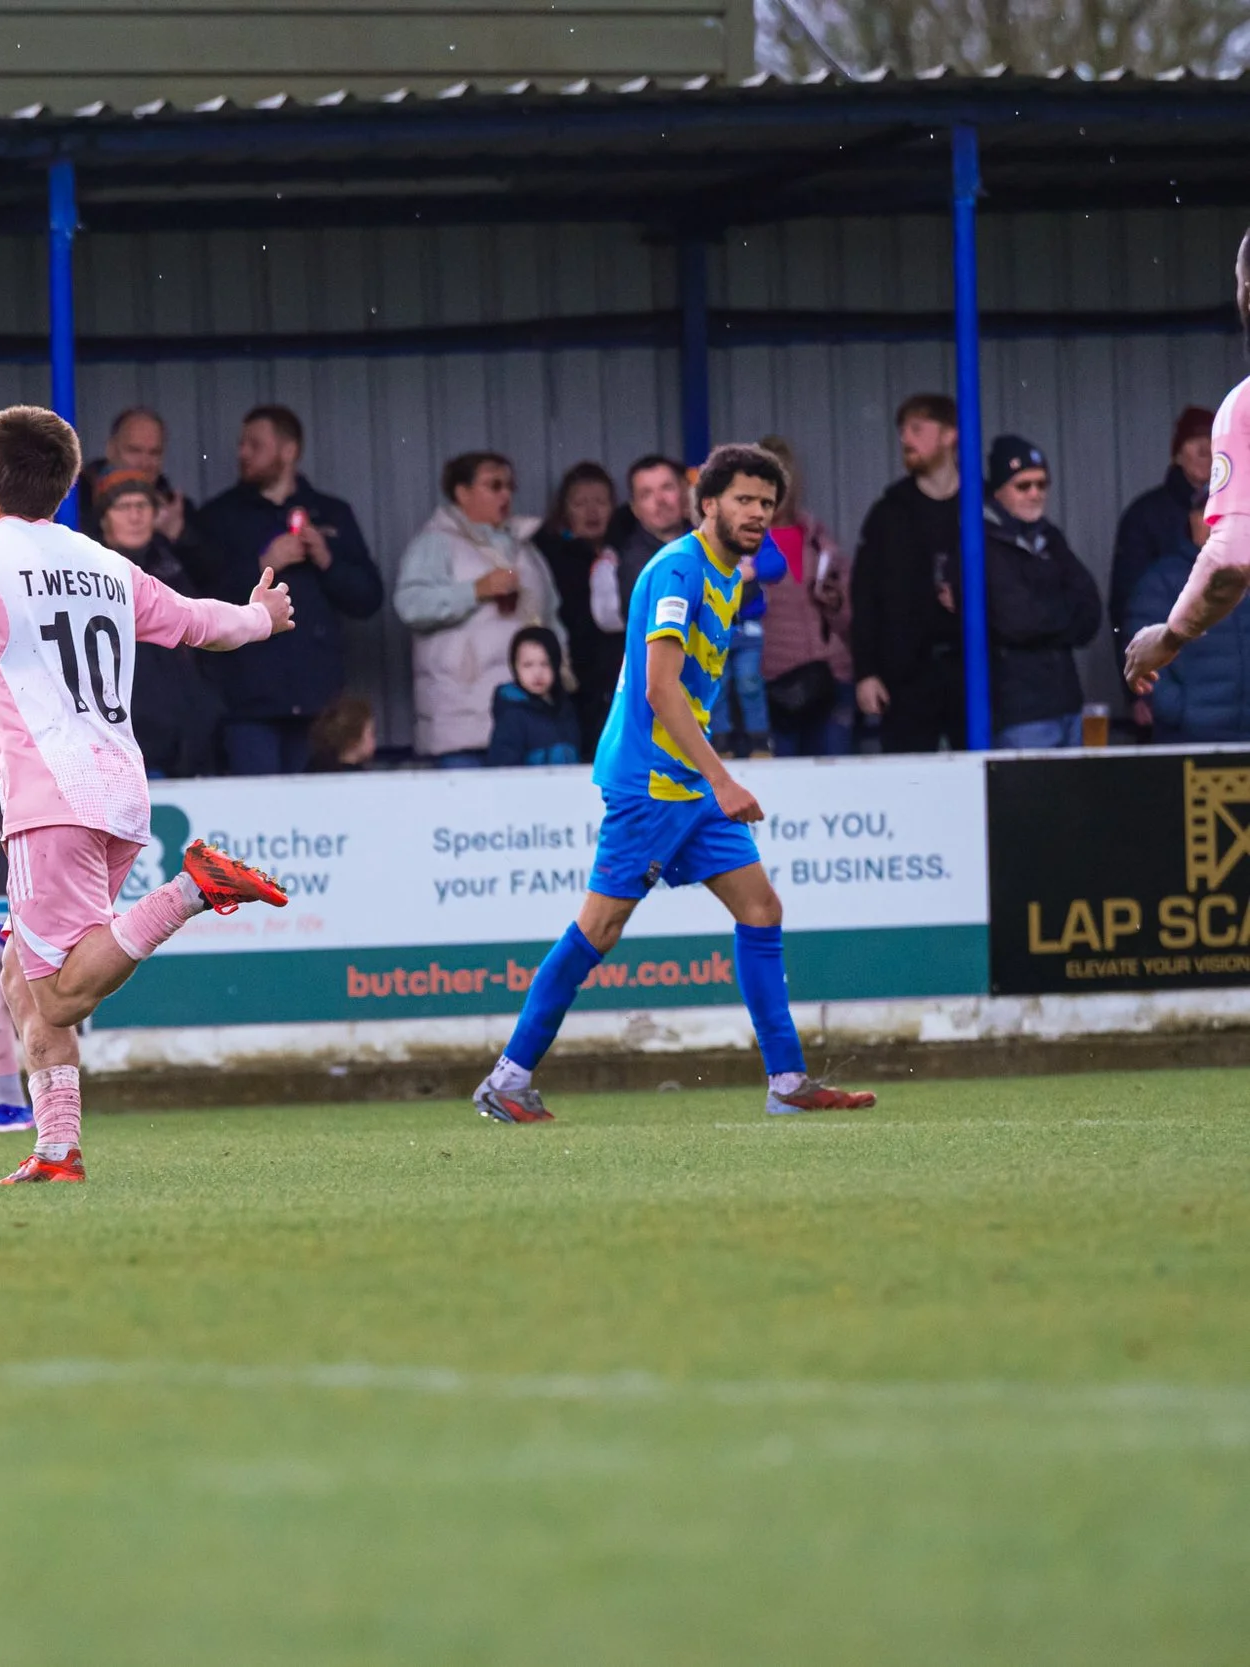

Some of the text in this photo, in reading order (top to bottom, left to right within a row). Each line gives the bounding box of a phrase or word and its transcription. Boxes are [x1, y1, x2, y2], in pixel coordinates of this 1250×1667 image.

[18, 569, 127, 606] T.WESTON
[39, 610, 128, 724] 10
[433, 823, 575, 859] Specialist
[769, 814, 809, 841] for
[820, 811, 895, 840] YOU,
[207, 827, 350, 862] Butcher
[434, 868, 591, 904] your FAMI
[791, 854, 951, 885] BUSINESS.
[1027, 892, 1250, 954] LAP SC
[1065, 957, 1141, 979] ELEVATE
[1142, 956, 1191, 975] YOUR
